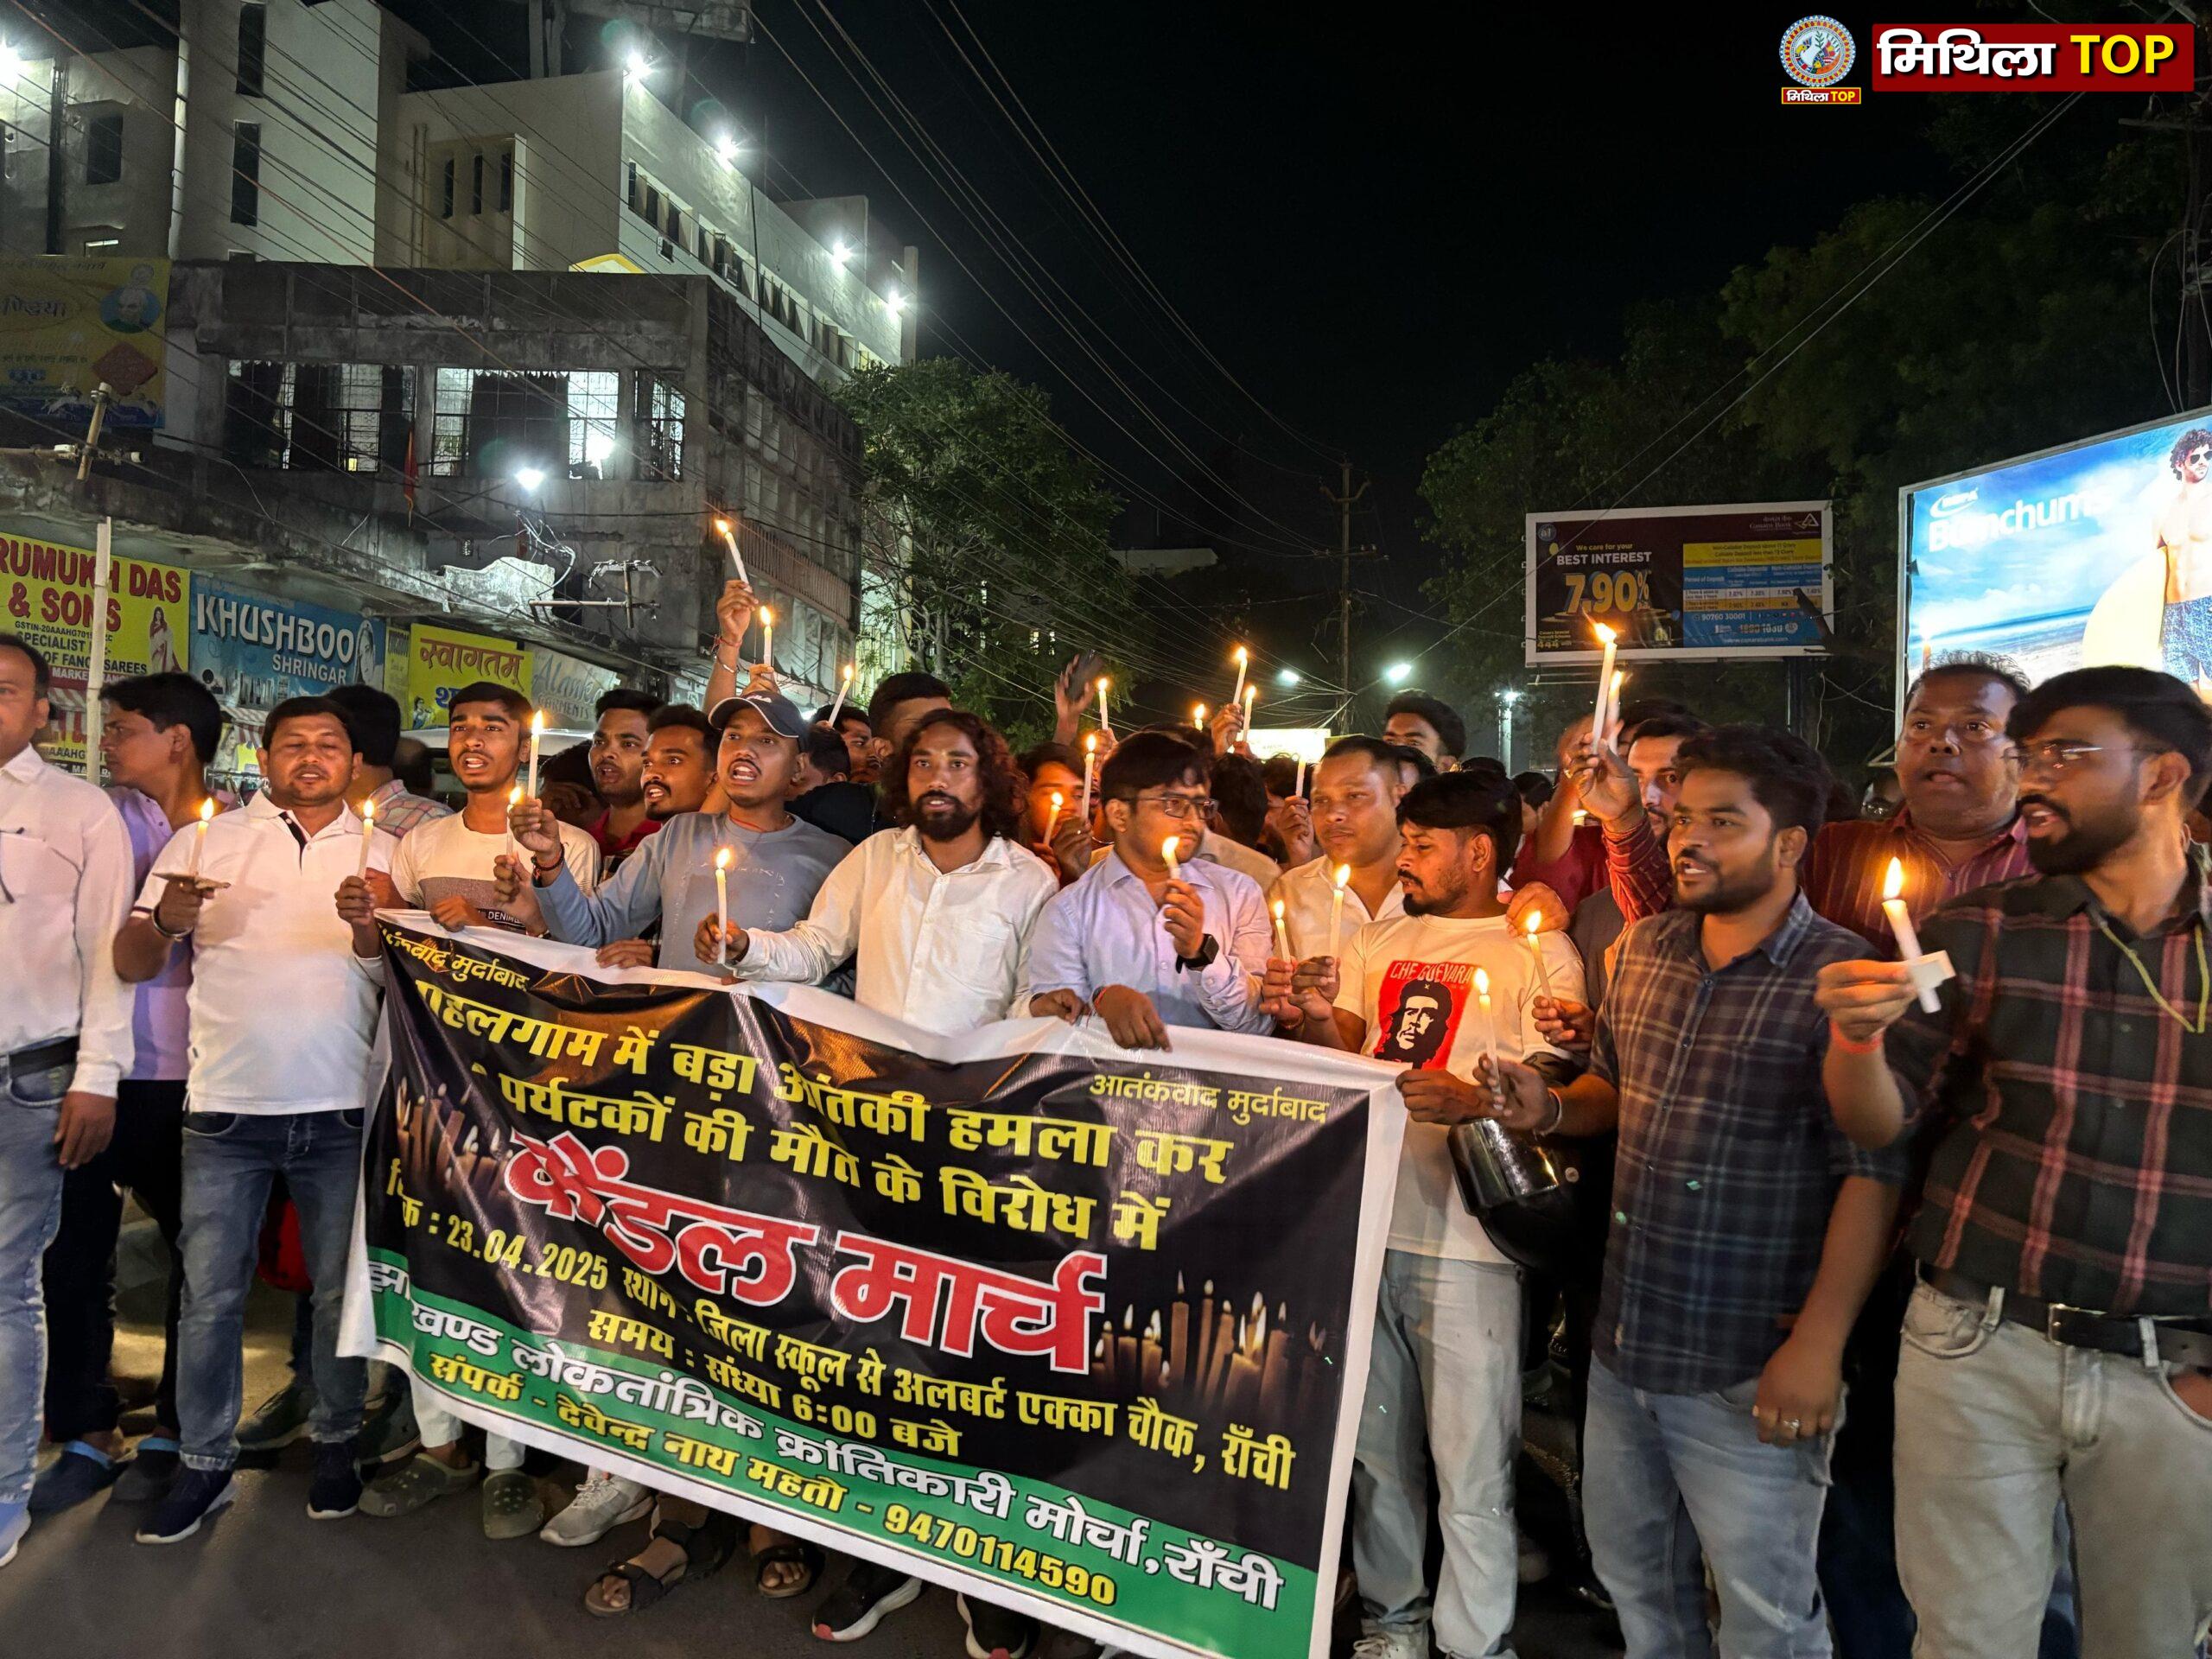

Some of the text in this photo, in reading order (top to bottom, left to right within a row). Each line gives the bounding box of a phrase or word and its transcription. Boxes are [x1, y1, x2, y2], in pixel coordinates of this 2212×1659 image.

[130, 563, 181, 603] DAS
[1556, 551, 1652, 566] BEST INTEREST
[8, 582, 31, 619] &
[196, 593, 356, 664] KHUSHBOO
[44, 652, 148, 675] OF FANC SAREES
[271, 653, 347, 685] SHRINGAR
[1390, 961, 1474, 984] CHE GUEVARA
[613, 1026, 660, 1075] में
[670, 1042, 763, 1103] बड़ा
[947, 1108, 1118, 1167] हमला
[1135, 1128, 1234, 1185] कर
[1089, 1071, 1330, 1126] आतंकवाद मुर्दाबाद
[499, 1071, 1172, 1250] पर्यटकों की मौत के विरोध में
[830, 1230, 1108, 1376] मार्च
[447, 1214, 608, 1291] 23.04.2025
[694, 1298, 772, 1363] जिला
[774, 1332, 853, 1394] स्कूल
[856, 1346, 887, 1397] से
[893, 1367, 1007, 1420] अलबर्ट
[1016, 1390, 1118, 1437] एक्का
[1128, 1395, 1206, 1474] चौक,
[588, 1308, 675, 1360] समय
[703, 1353, 781, 1409] संध्या
[791, 1393, 877, 1440] 6:00
[889, 1416, 963, 1458] बजे
[511, 1338, 766, 1440] लोकतांत्रिक
[774, 1427, 1018, 1520] क्रांतिकारी
[429, 1351, 524, 1402] संपर्क
[556, 1393, 657, 1452] देवेन्द्र
[663, 1430, 741, 1477] नाथ
[747, 1457, 849, 1512] महतो
[883, 1503, 1116, 1606] 9470114590
